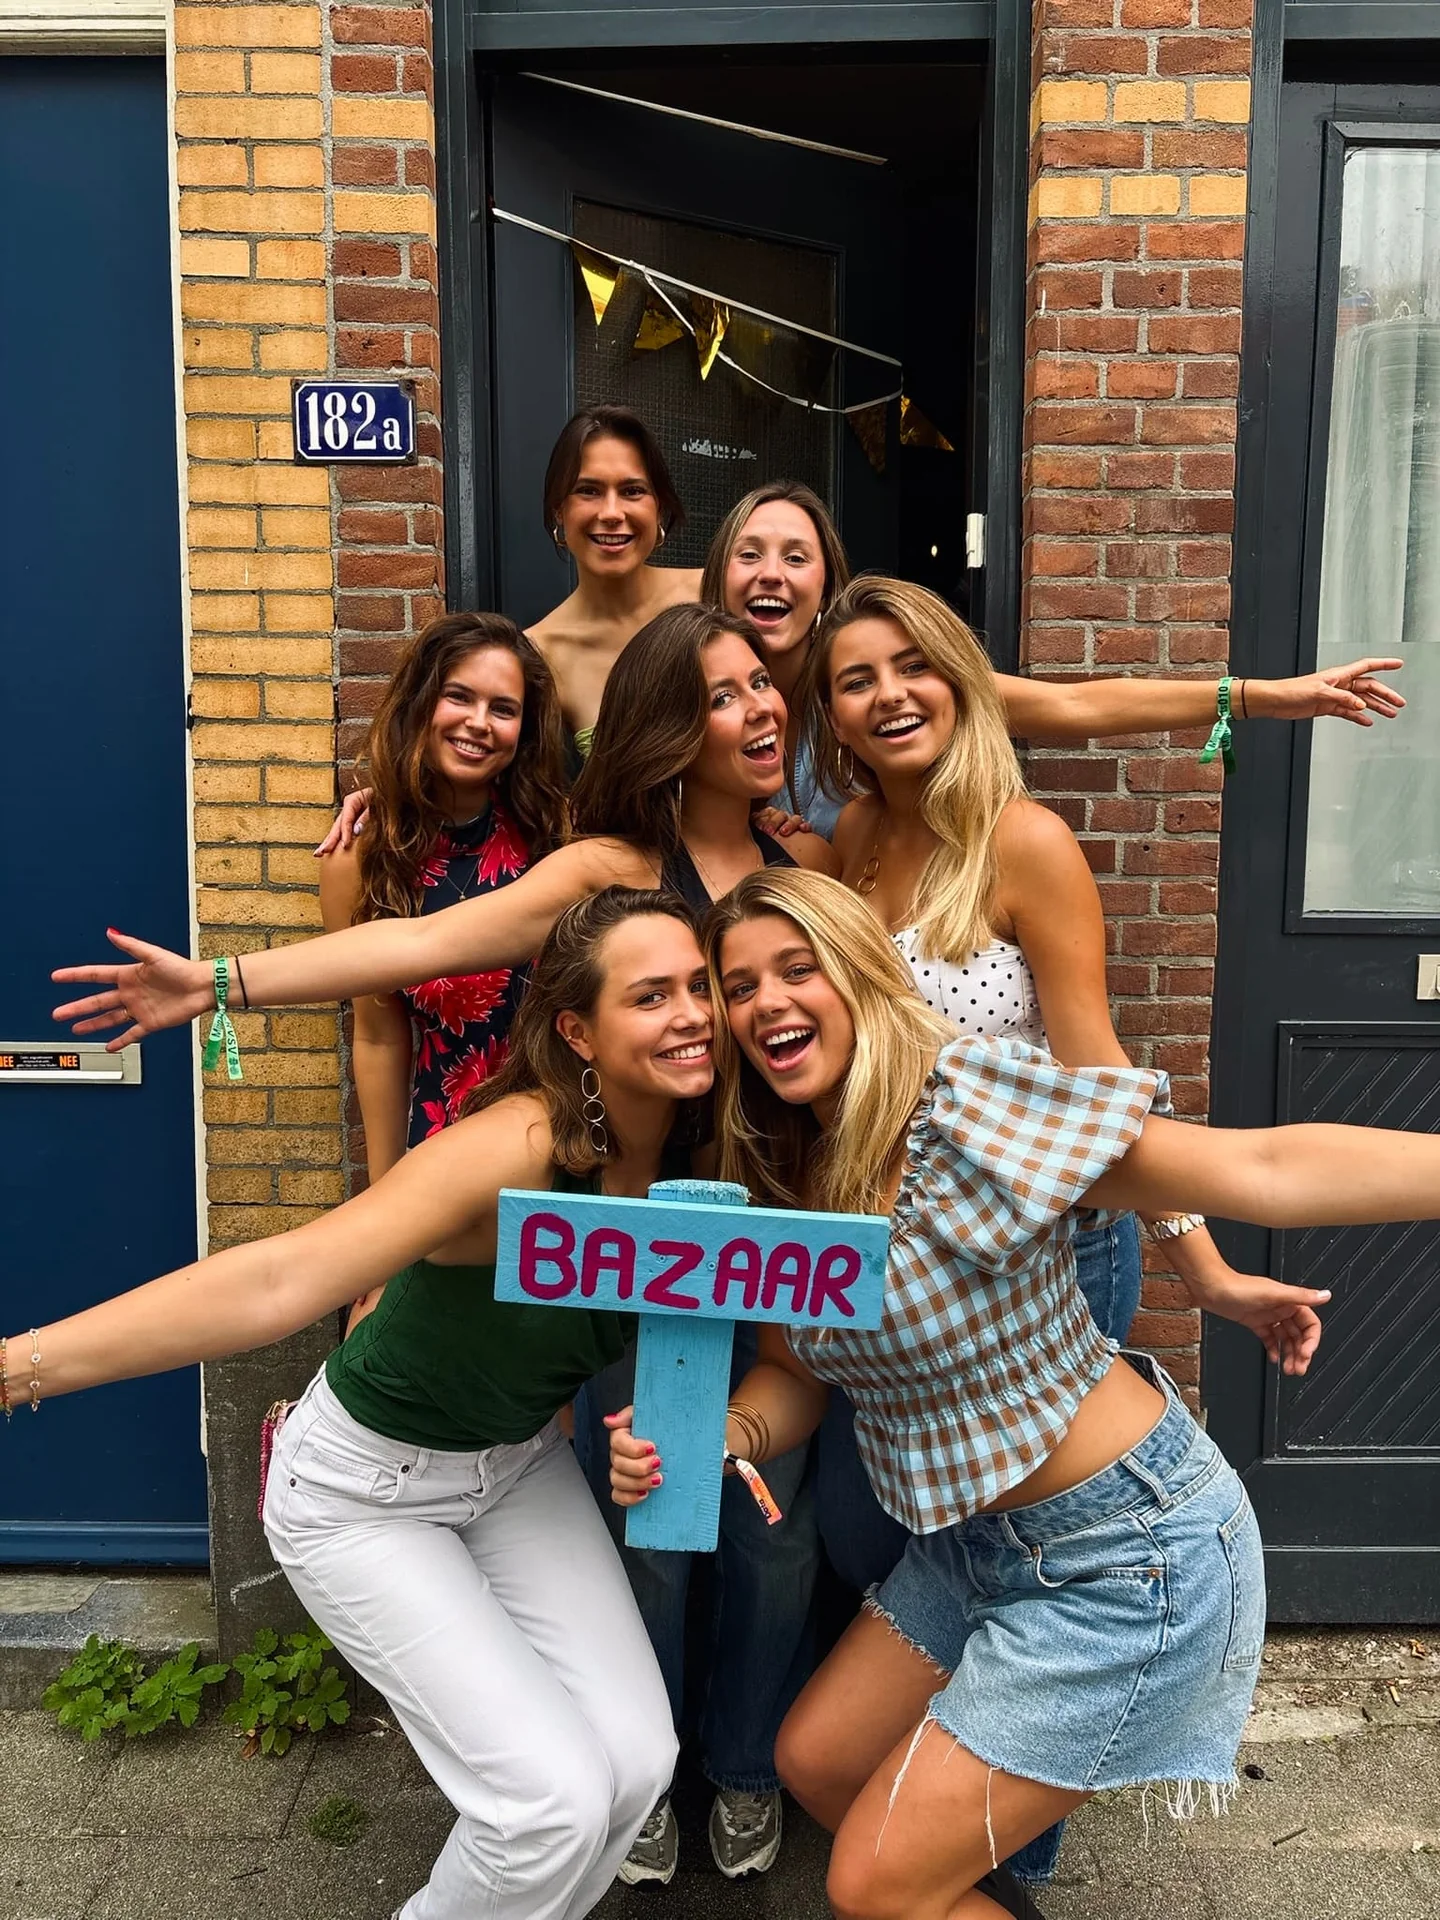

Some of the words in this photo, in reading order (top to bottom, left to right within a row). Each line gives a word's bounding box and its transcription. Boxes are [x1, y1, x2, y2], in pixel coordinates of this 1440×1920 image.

[305, 391, 402, 450] 182a
[59, 1055, 78, 1067] NEE
[519, 1212, 861, 1318] BAZAAR
